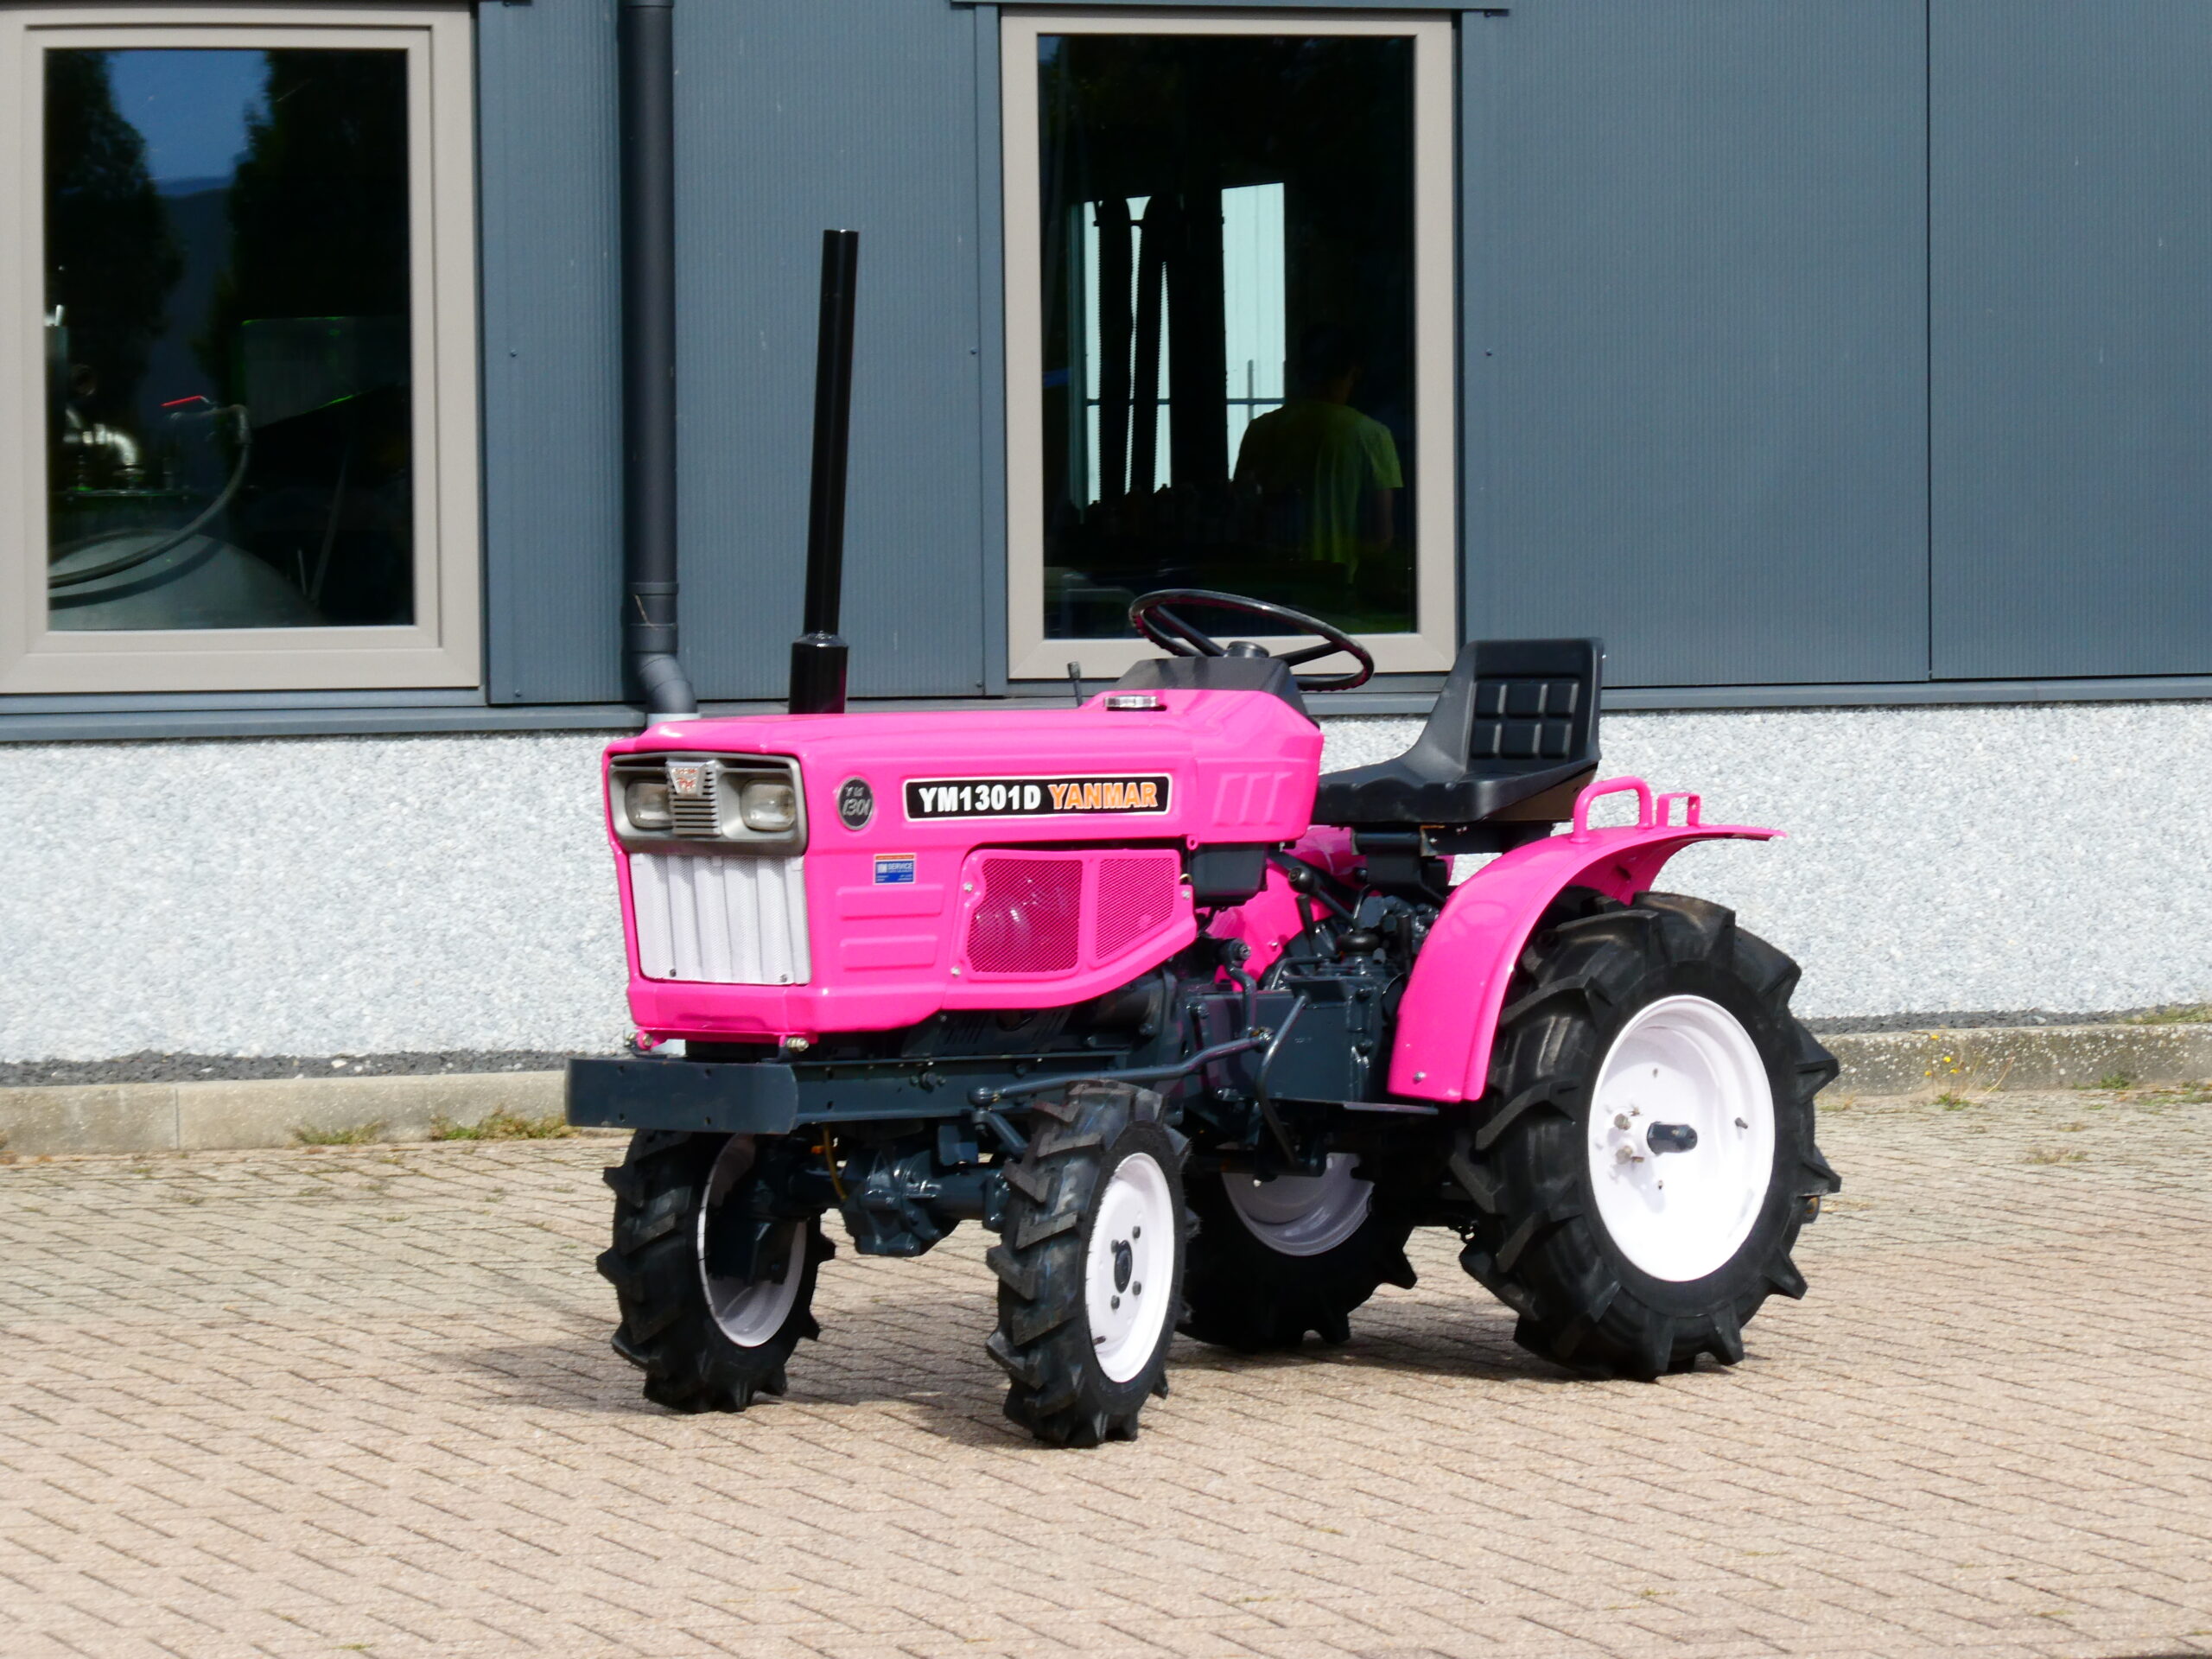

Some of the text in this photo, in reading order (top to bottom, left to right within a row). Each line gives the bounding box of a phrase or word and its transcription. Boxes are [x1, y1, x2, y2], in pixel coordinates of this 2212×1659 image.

[842, 798, 871, 816] 1301
[918, 782, 1159, 812] YM1301D YANMAR
